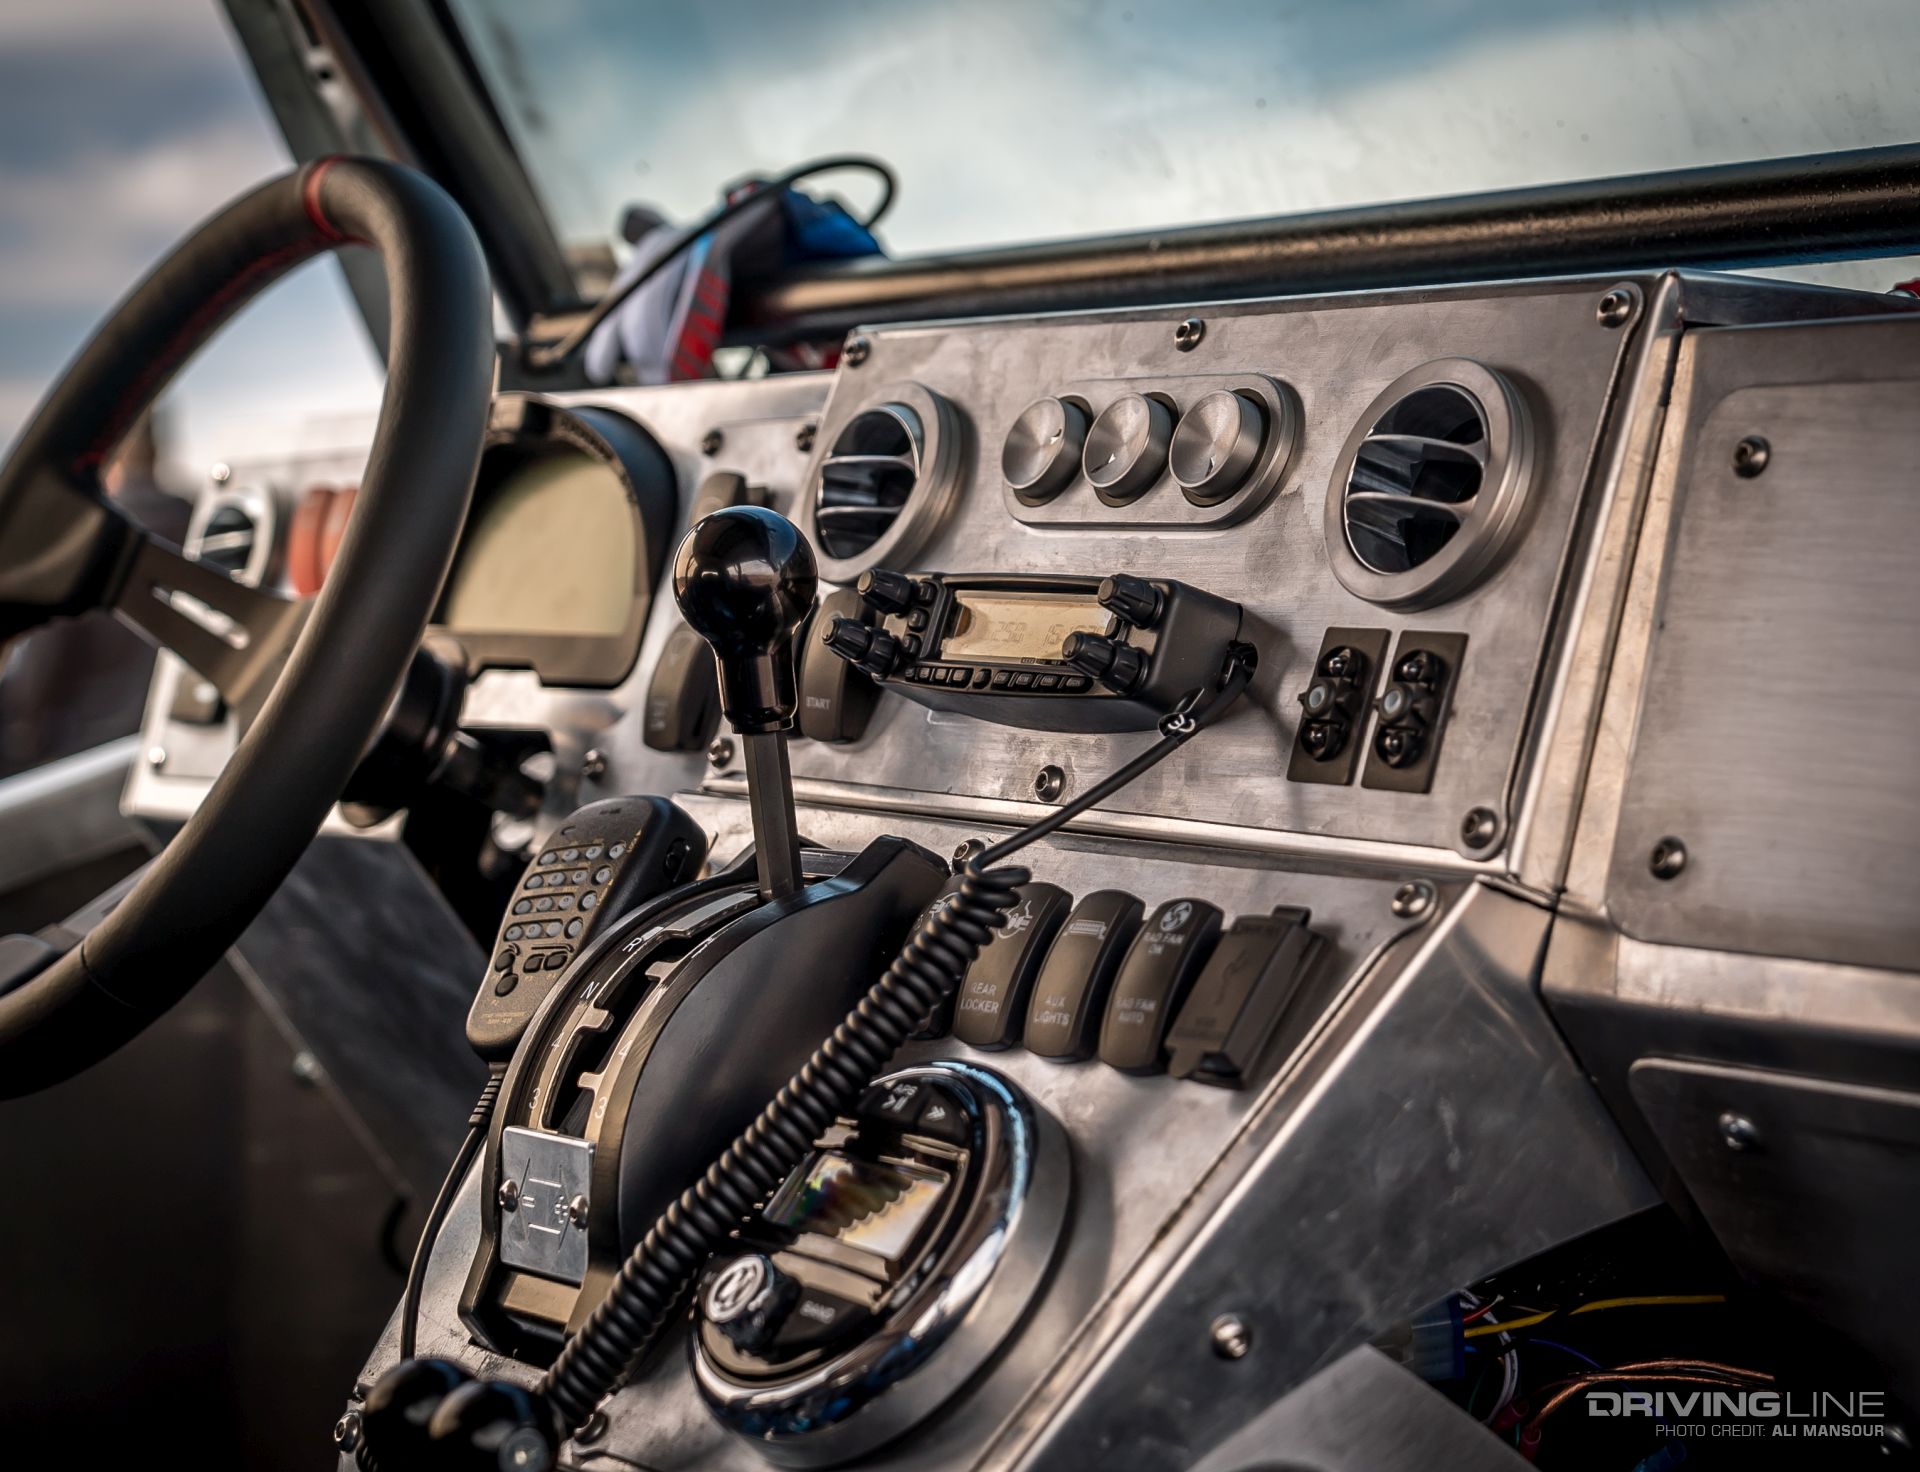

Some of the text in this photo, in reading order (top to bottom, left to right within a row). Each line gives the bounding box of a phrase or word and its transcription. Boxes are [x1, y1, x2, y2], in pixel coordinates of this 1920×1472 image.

[805, 695, 832, 710] START
[622, 937, 643, 953] R
[1162, 933, 1185, 945] FAN
[579, 981, 600, 999] N
[970, 982, 997, 996] REAR
[960, 998, 999, 1014] LOCKER
[1045, 995, 1067, 1009] AUX
[1135, 998, 1157, 1011] FAN
[1033, 1010, 1071, 1027] LIGHTS
[1118, 1011, 1145, 1024] AUTO
[551, 1032, 565, 1049] 4
[618, 1039, 633, 1061] 4
[528, 1087, 541, 1109] 3
[594, 1096, 608, 1119] 3
[799, 1300, 836, 1325] BAND
